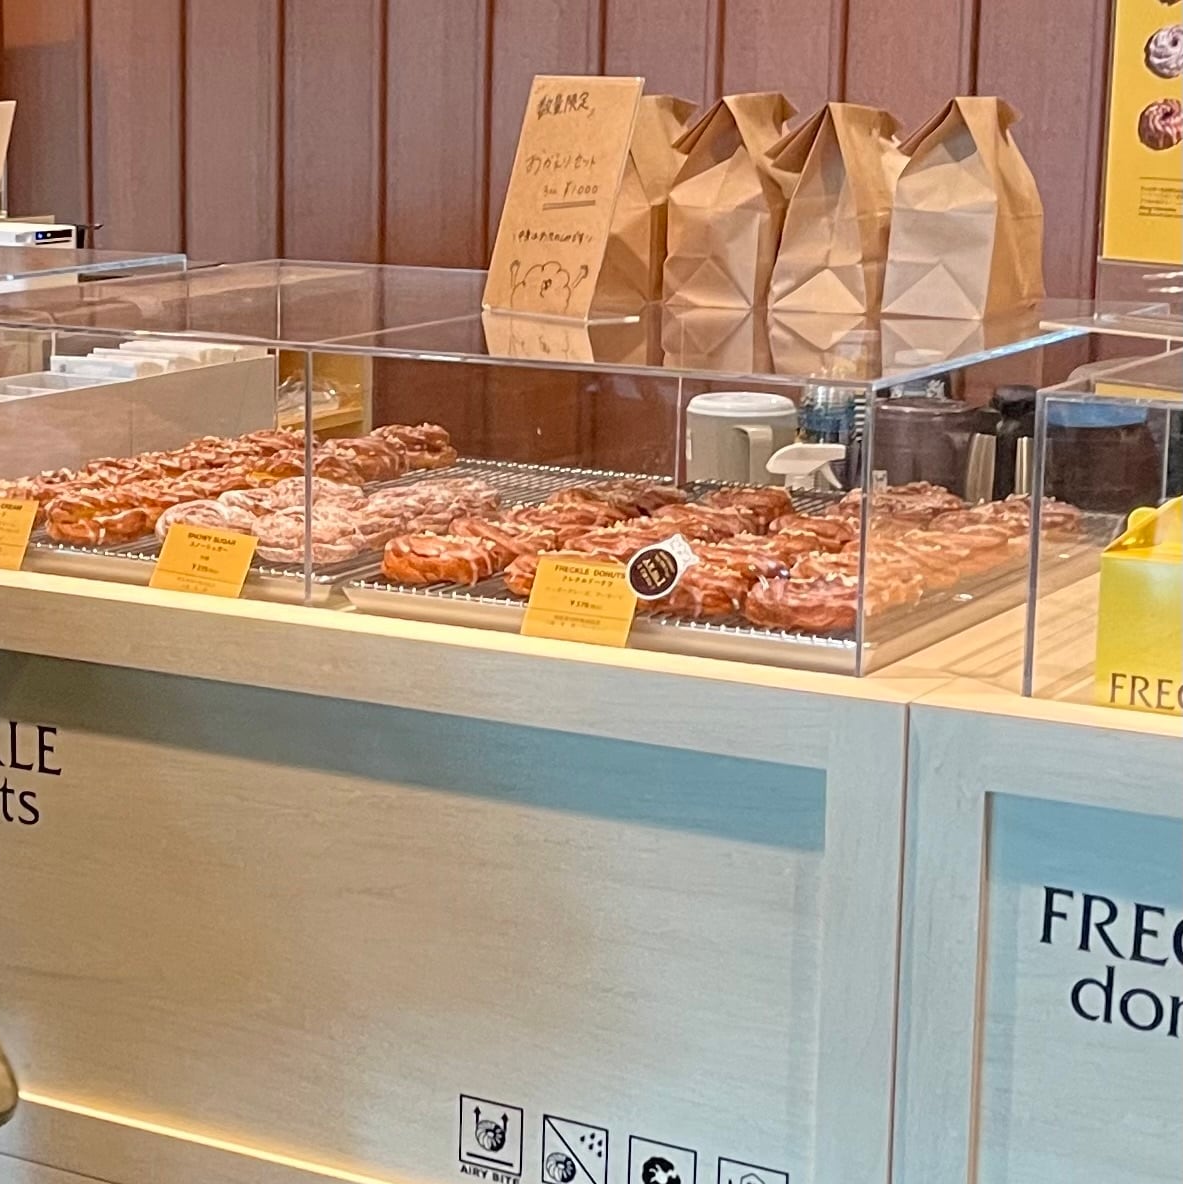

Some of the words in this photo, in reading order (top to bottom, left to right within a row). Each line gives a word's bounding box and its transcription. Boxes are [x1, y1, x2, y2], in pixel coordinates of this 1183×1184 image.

[555, 564, 590, 576] FRECKLE
[1109, 672, 1183, 711] FRE
[1040, 885, 1183, 967] FRE
[460, 1164, 488, 1179] AIRY
